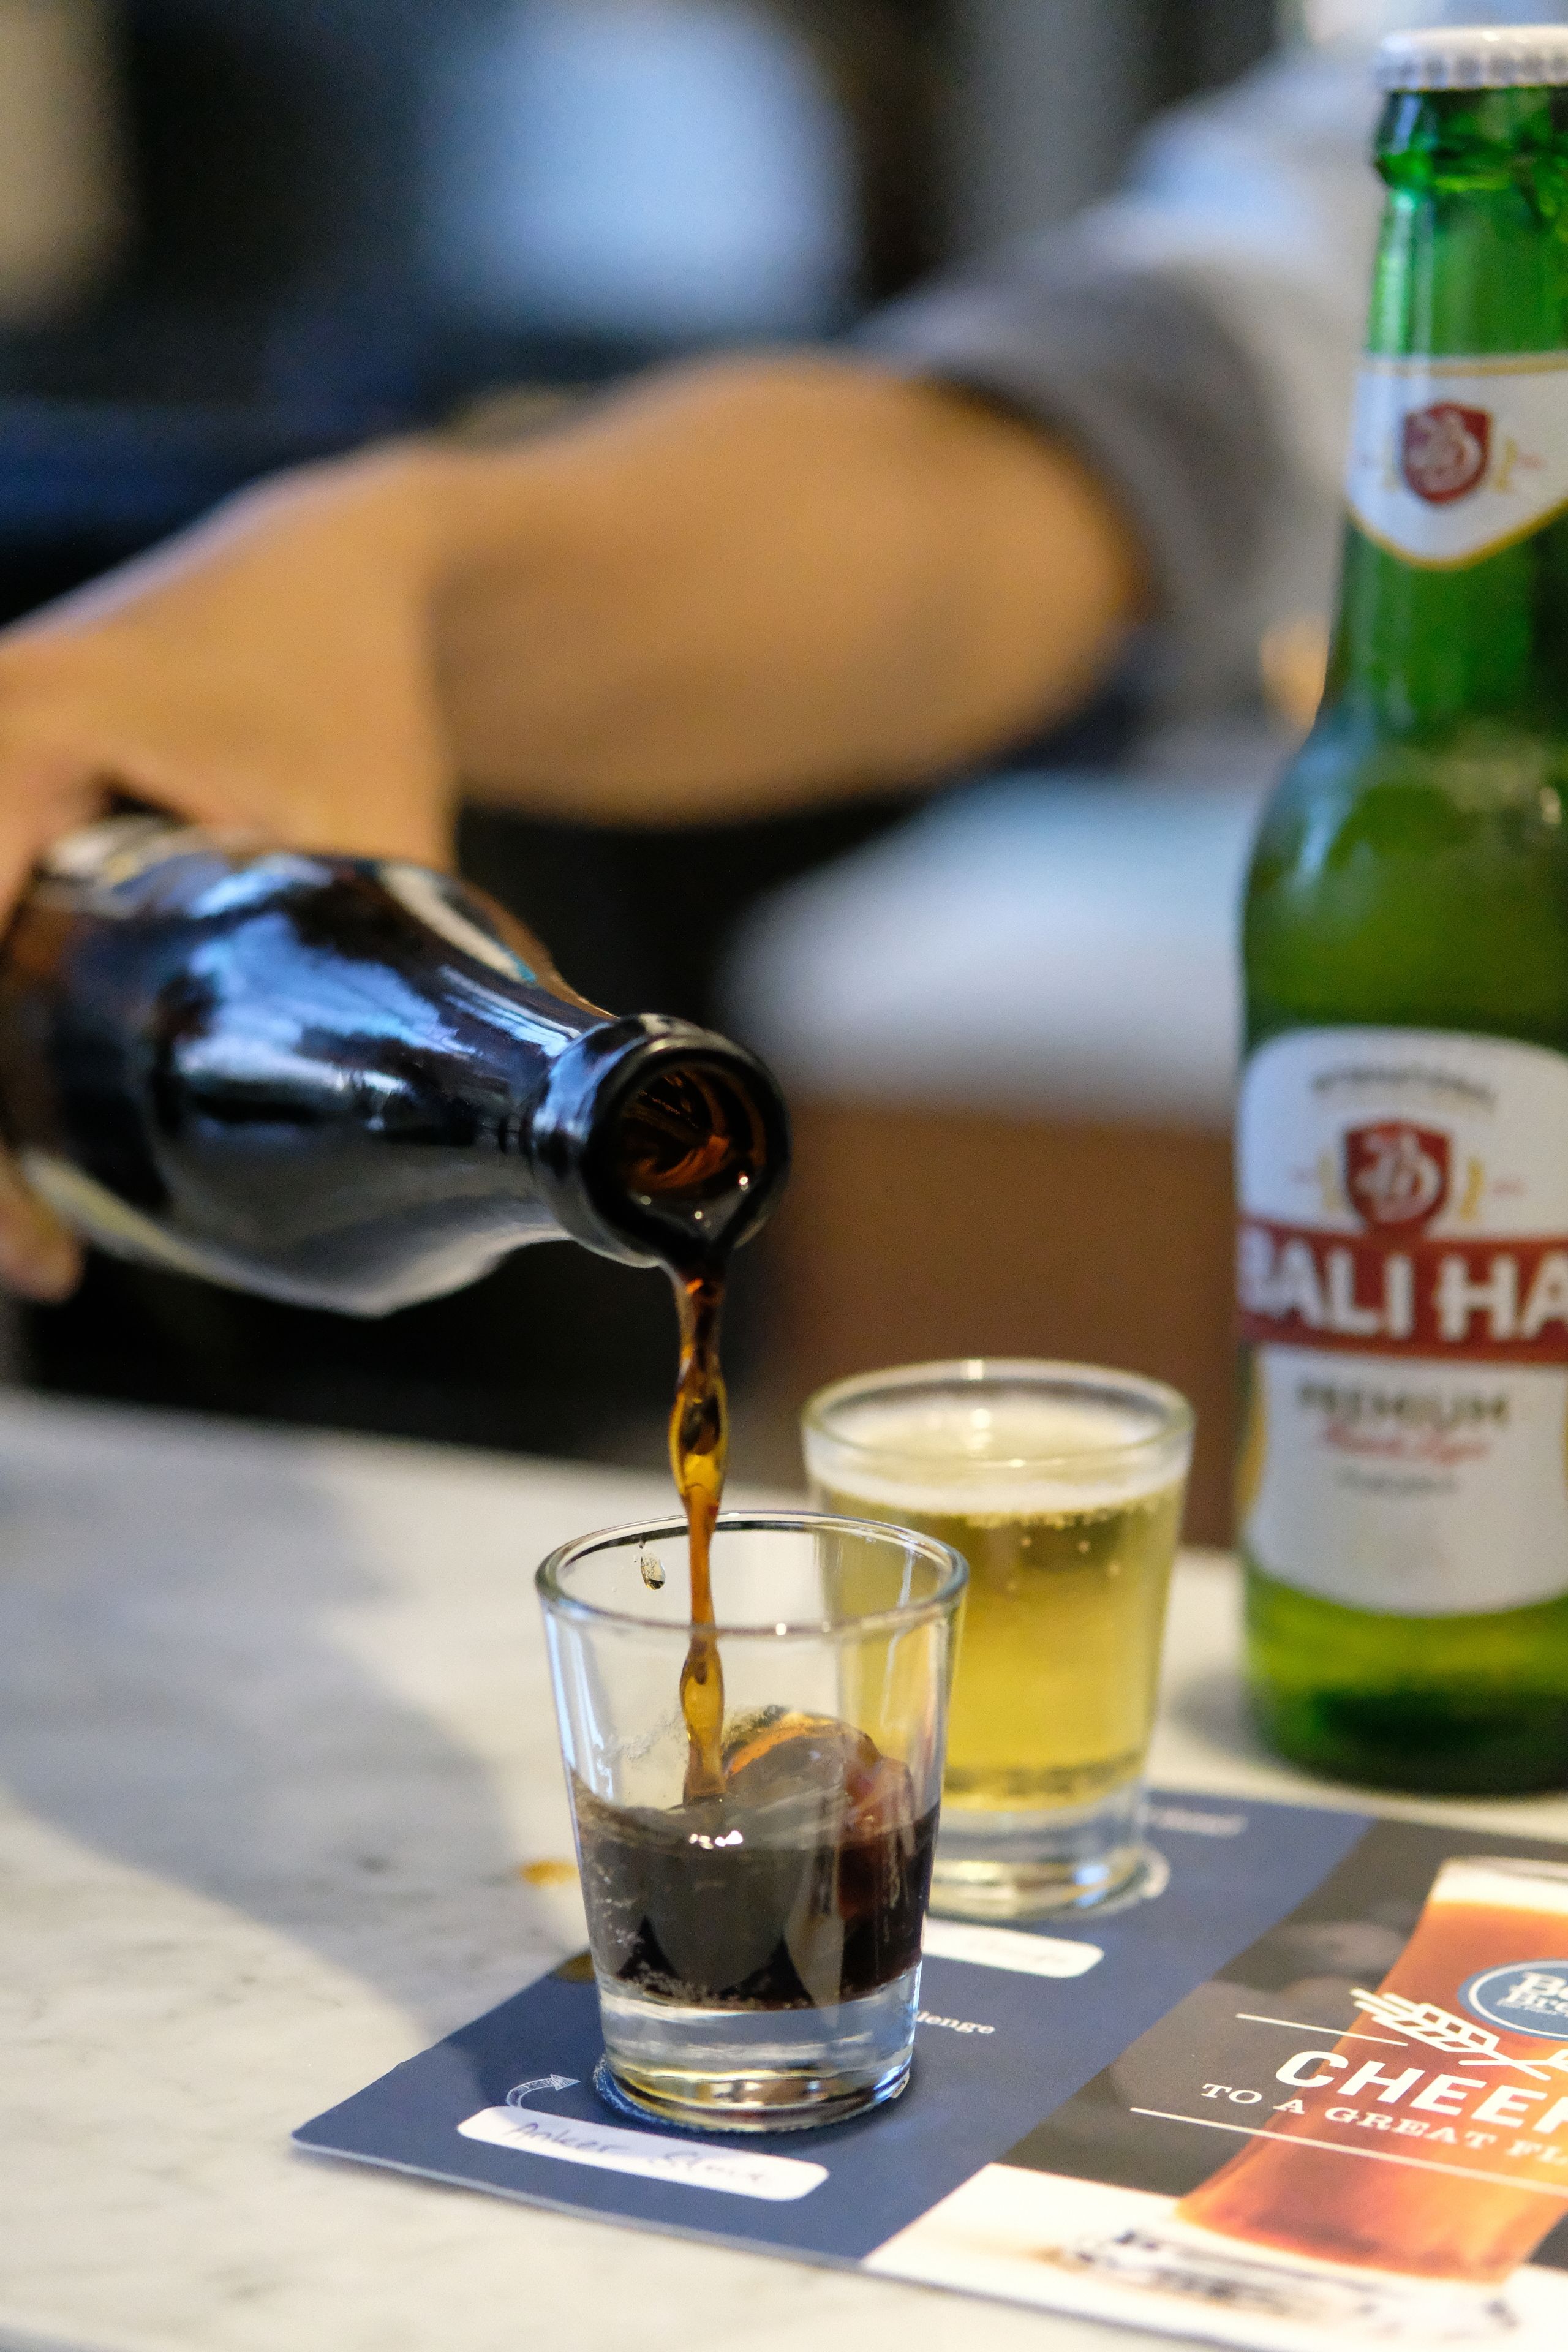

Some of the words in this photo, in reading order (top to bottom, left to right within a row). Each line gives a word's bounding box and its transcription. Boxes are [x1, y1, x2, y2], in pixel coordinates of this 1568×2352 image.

[1201, 2083, 1262, 2104] TO
[1273, 2099, 1305, 2115] A
[1324, 2106, 1498, 2149] GREAT
